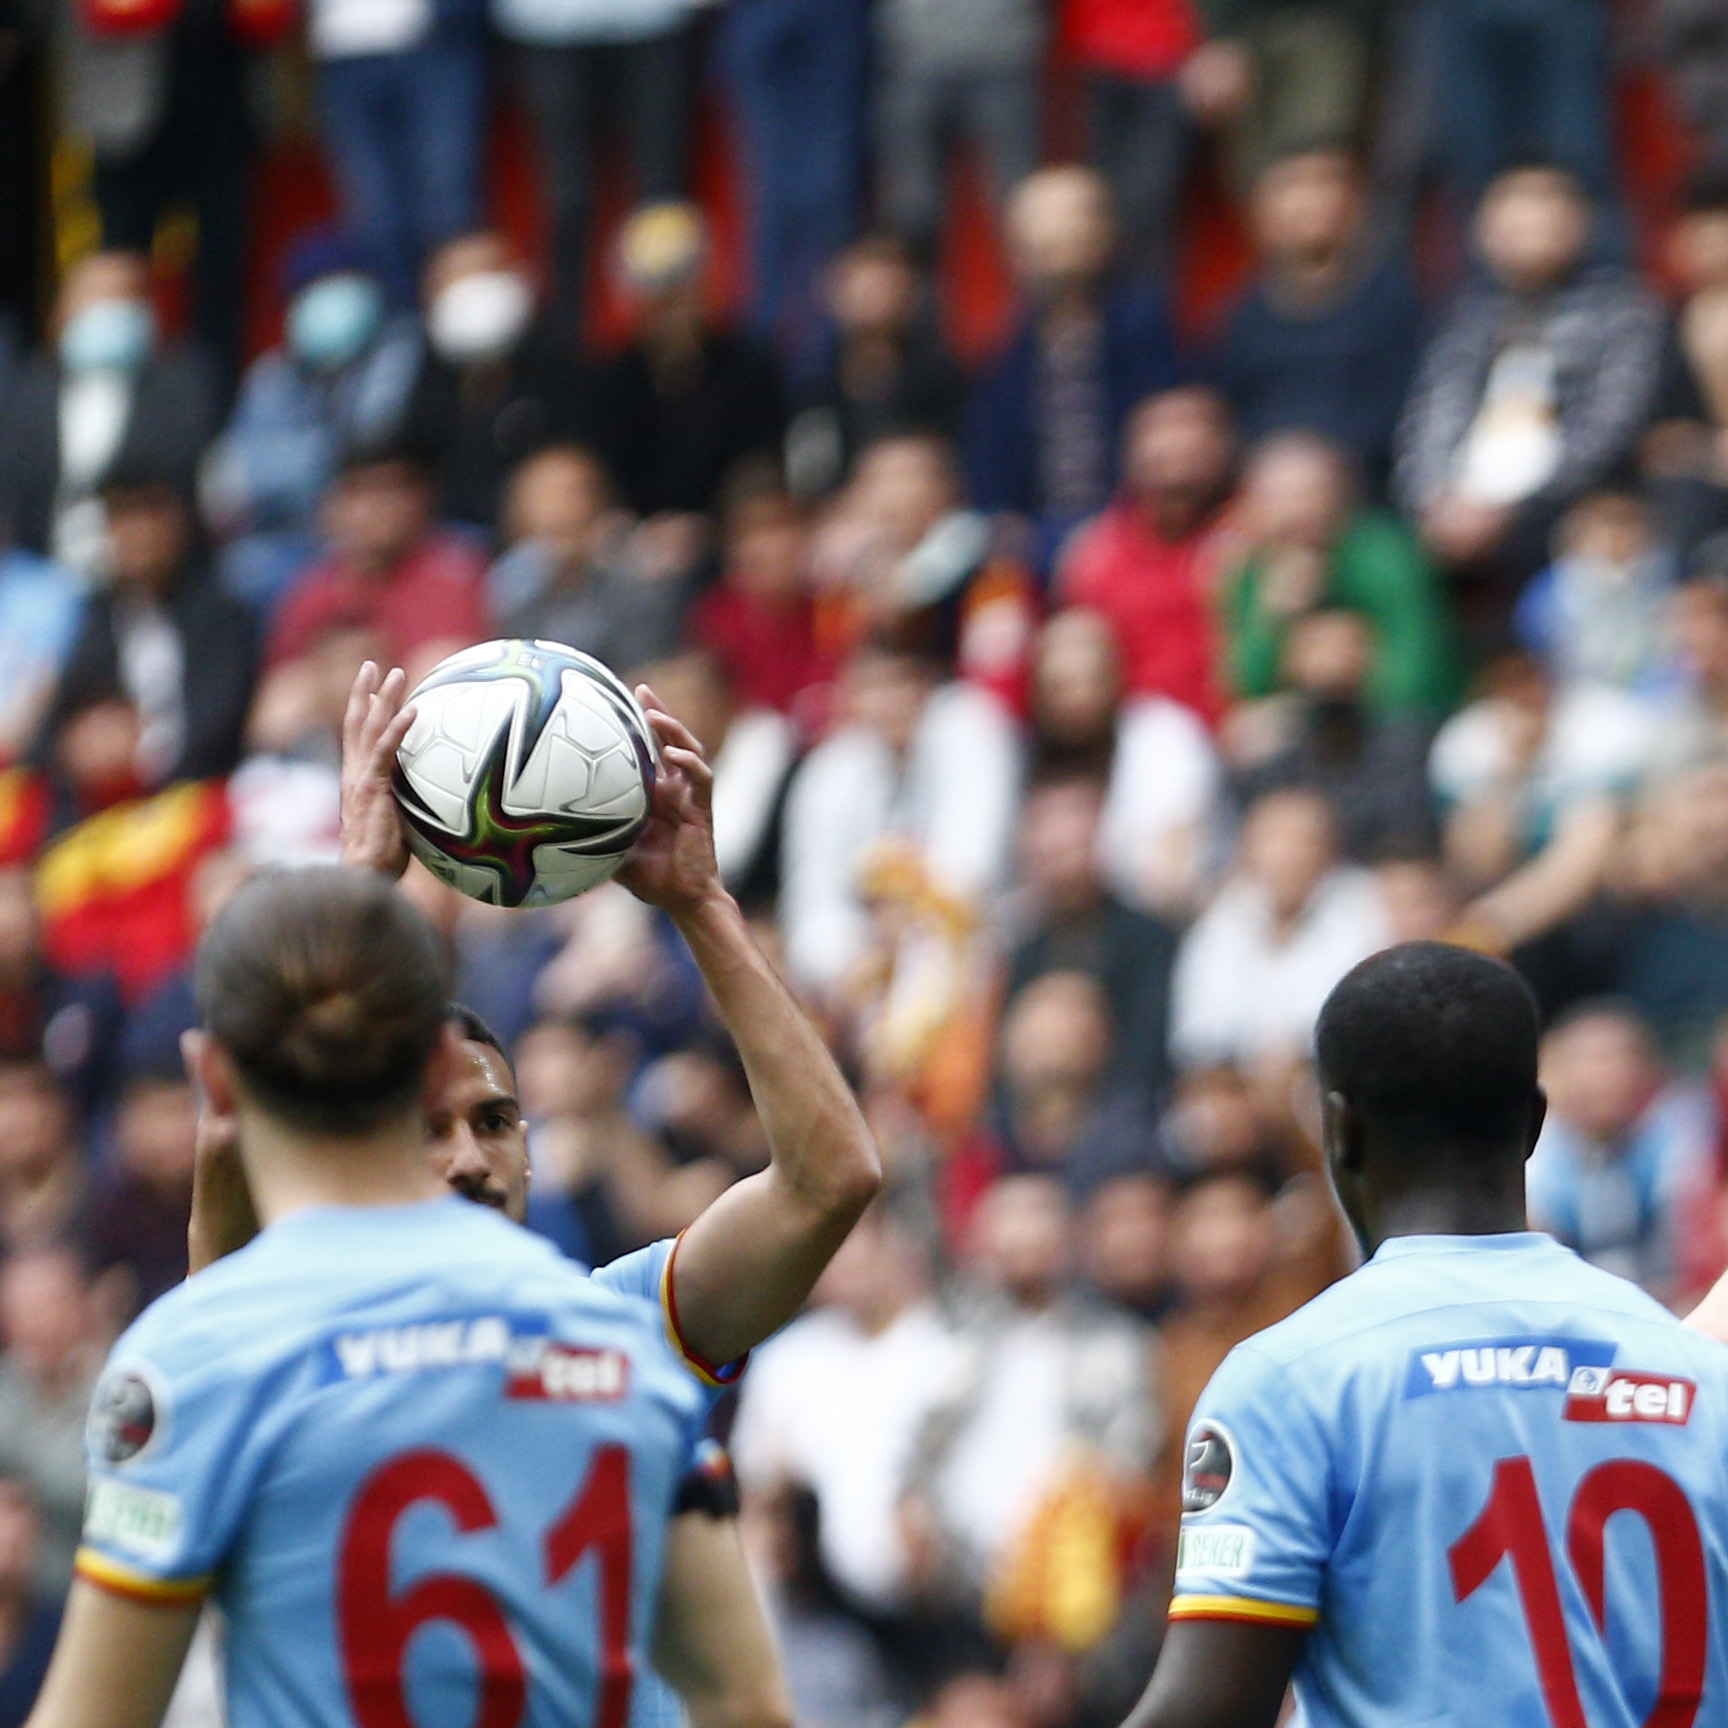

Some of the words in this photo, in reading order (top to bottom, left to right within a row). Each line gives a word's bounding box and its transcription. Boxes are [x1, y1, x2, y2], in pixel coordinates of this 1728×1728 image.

[335, 1316, 506, 1378] YUKA
[1420, 1344, 1572, 1389] YUKA
[1602, 1370, 1688, 1418] tel
